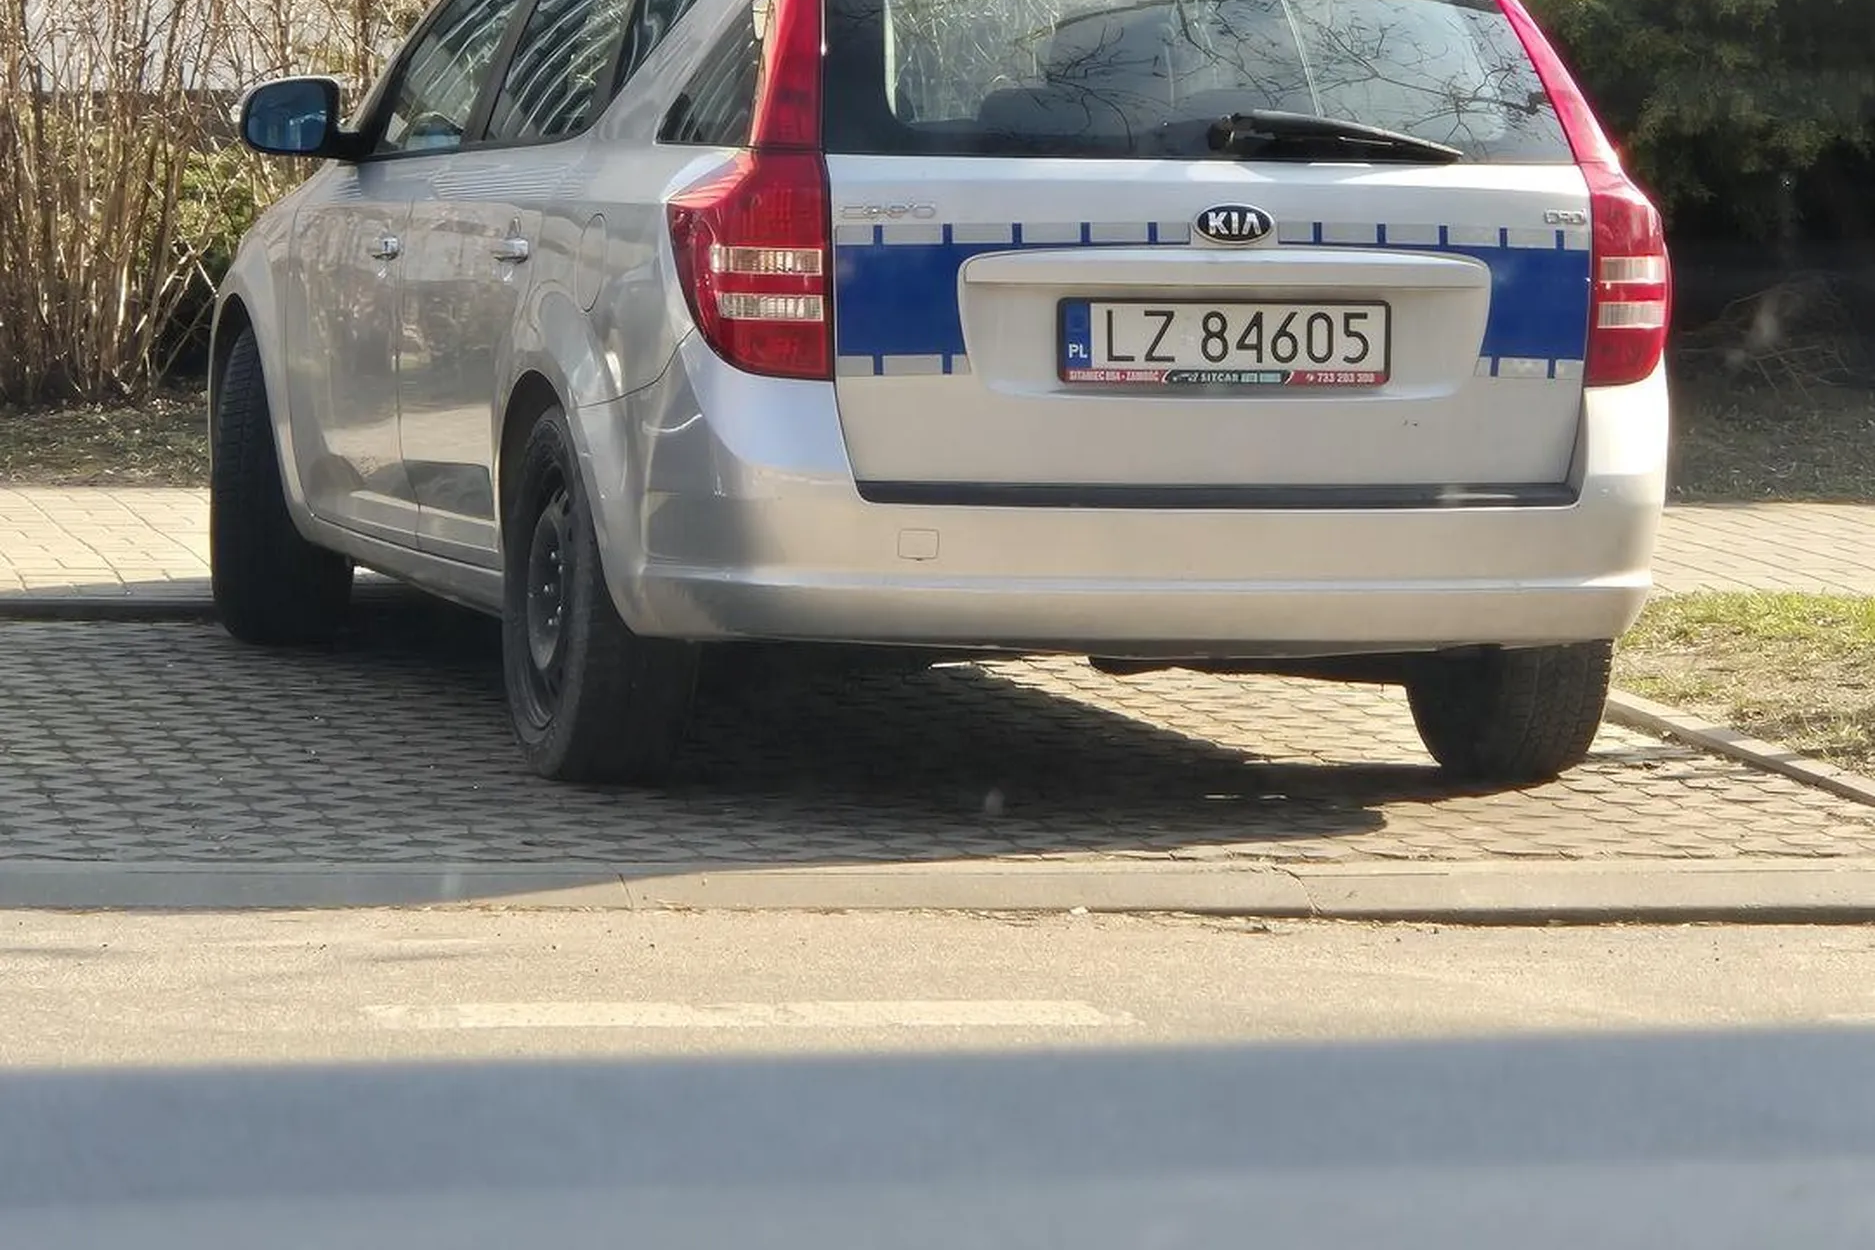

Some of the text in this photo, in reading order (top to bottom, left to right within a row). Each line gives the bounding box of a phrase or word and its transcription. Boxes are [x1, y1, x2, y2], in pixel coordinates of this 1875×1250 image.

[1207, 211, 1262, 235] KIA
[1106, 309, 1369, 364] LZ 84605
[1069, 343, 1088, 359] PL
